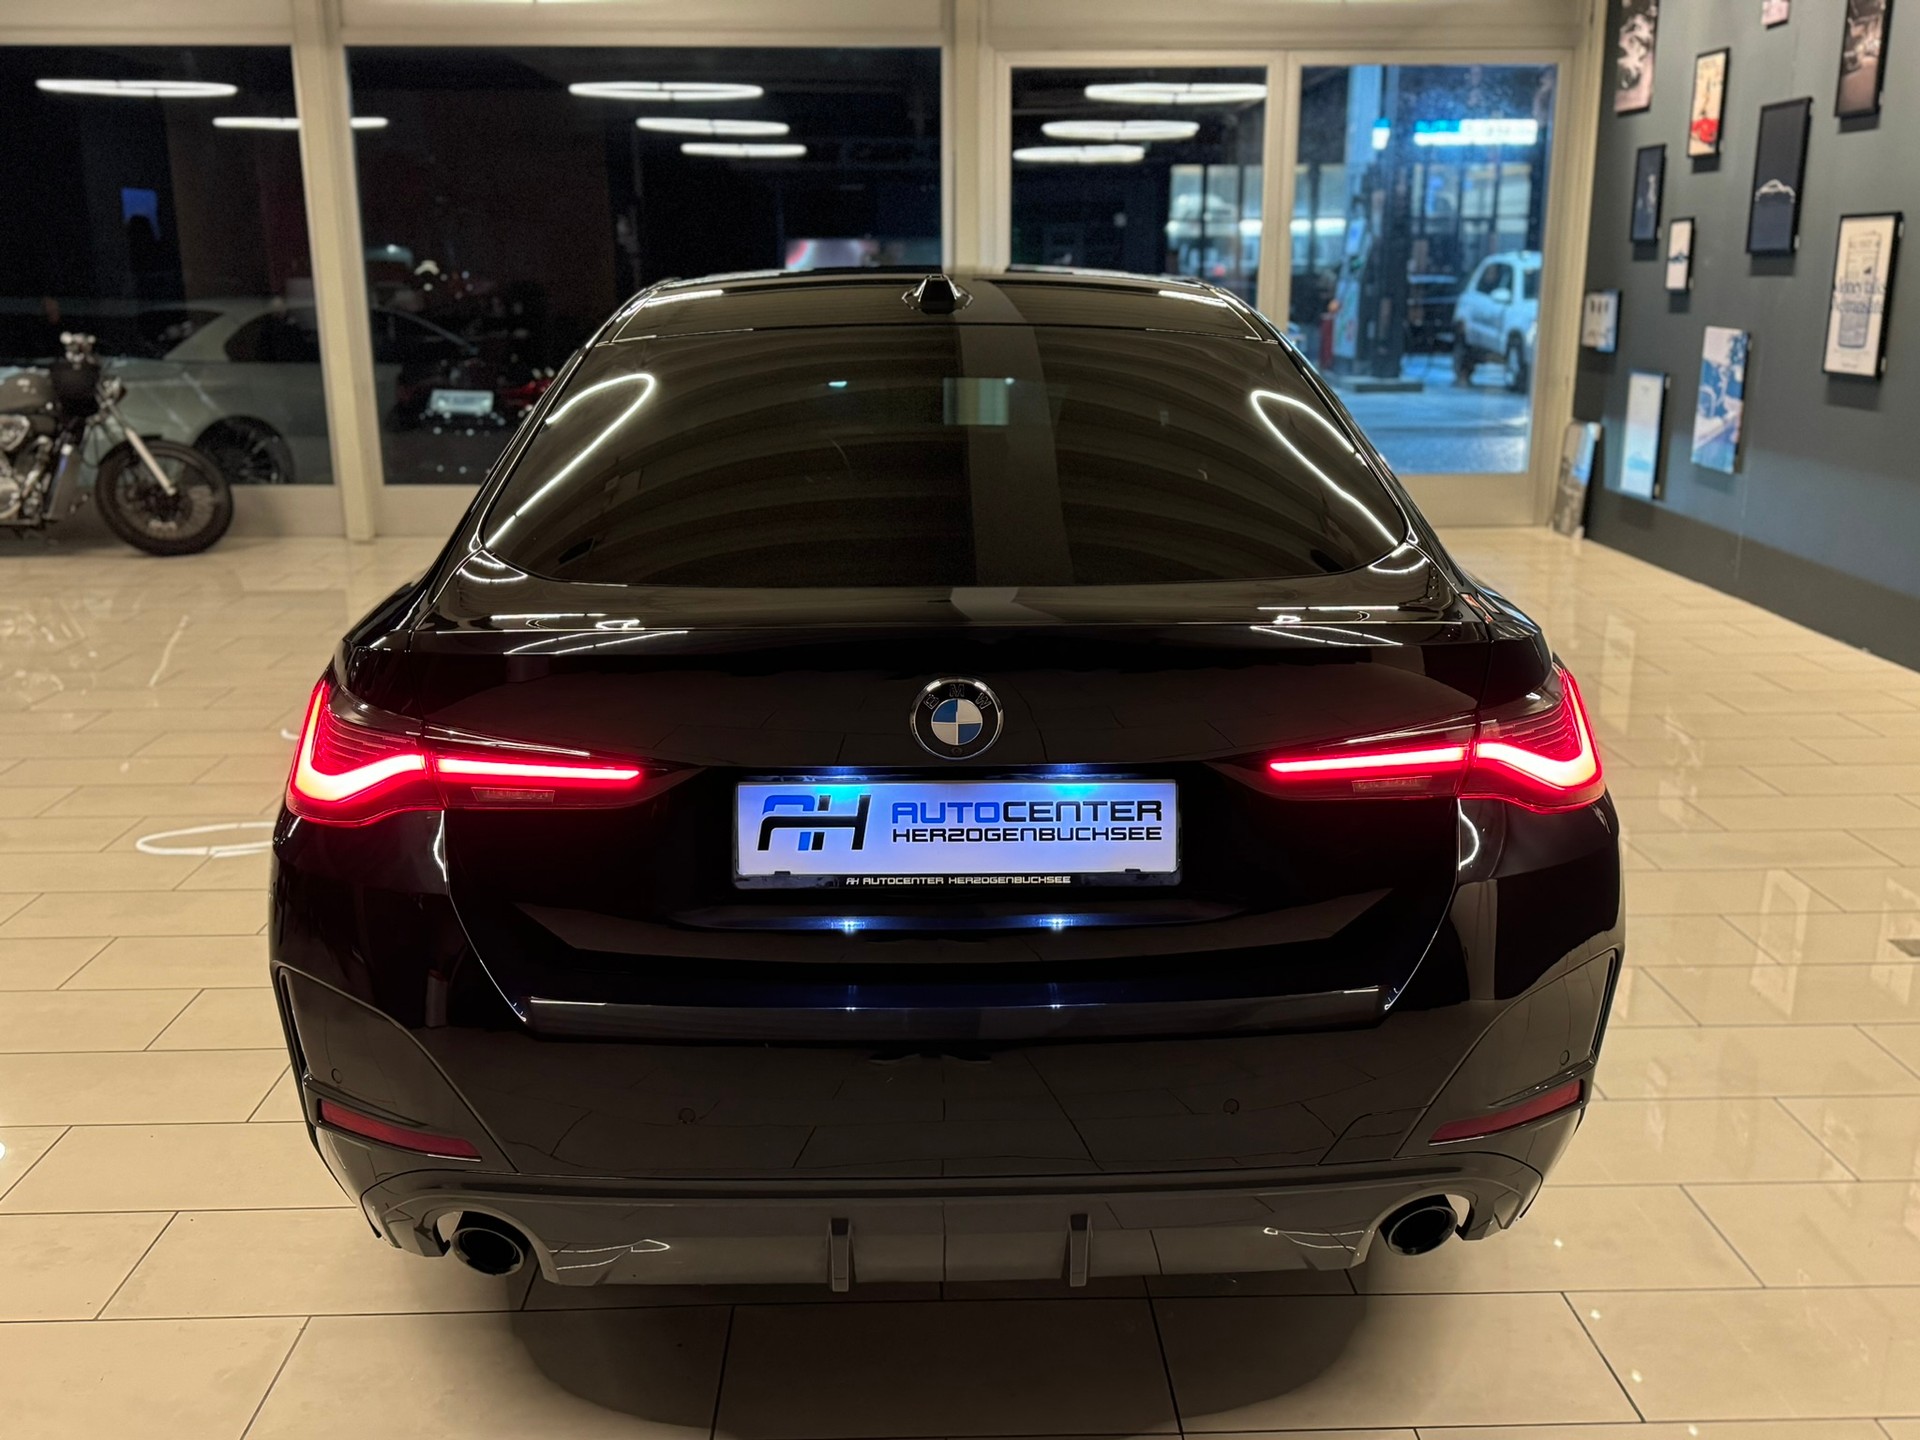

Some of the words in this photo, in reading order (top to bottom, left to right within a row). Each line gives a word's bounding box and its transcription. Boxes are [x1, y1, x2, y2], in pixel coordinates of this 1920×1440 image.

[923, 683, 992, 710] BMW
[892, 800, 1163, 824] AUTOCENTER
[892, 826, 1163, 843] HERZOGENBUCHSEE
[862, 876, 944, 885] AUTOCENTER
[948, 875, 1071, 885] HERZOGENBUCHSEE
